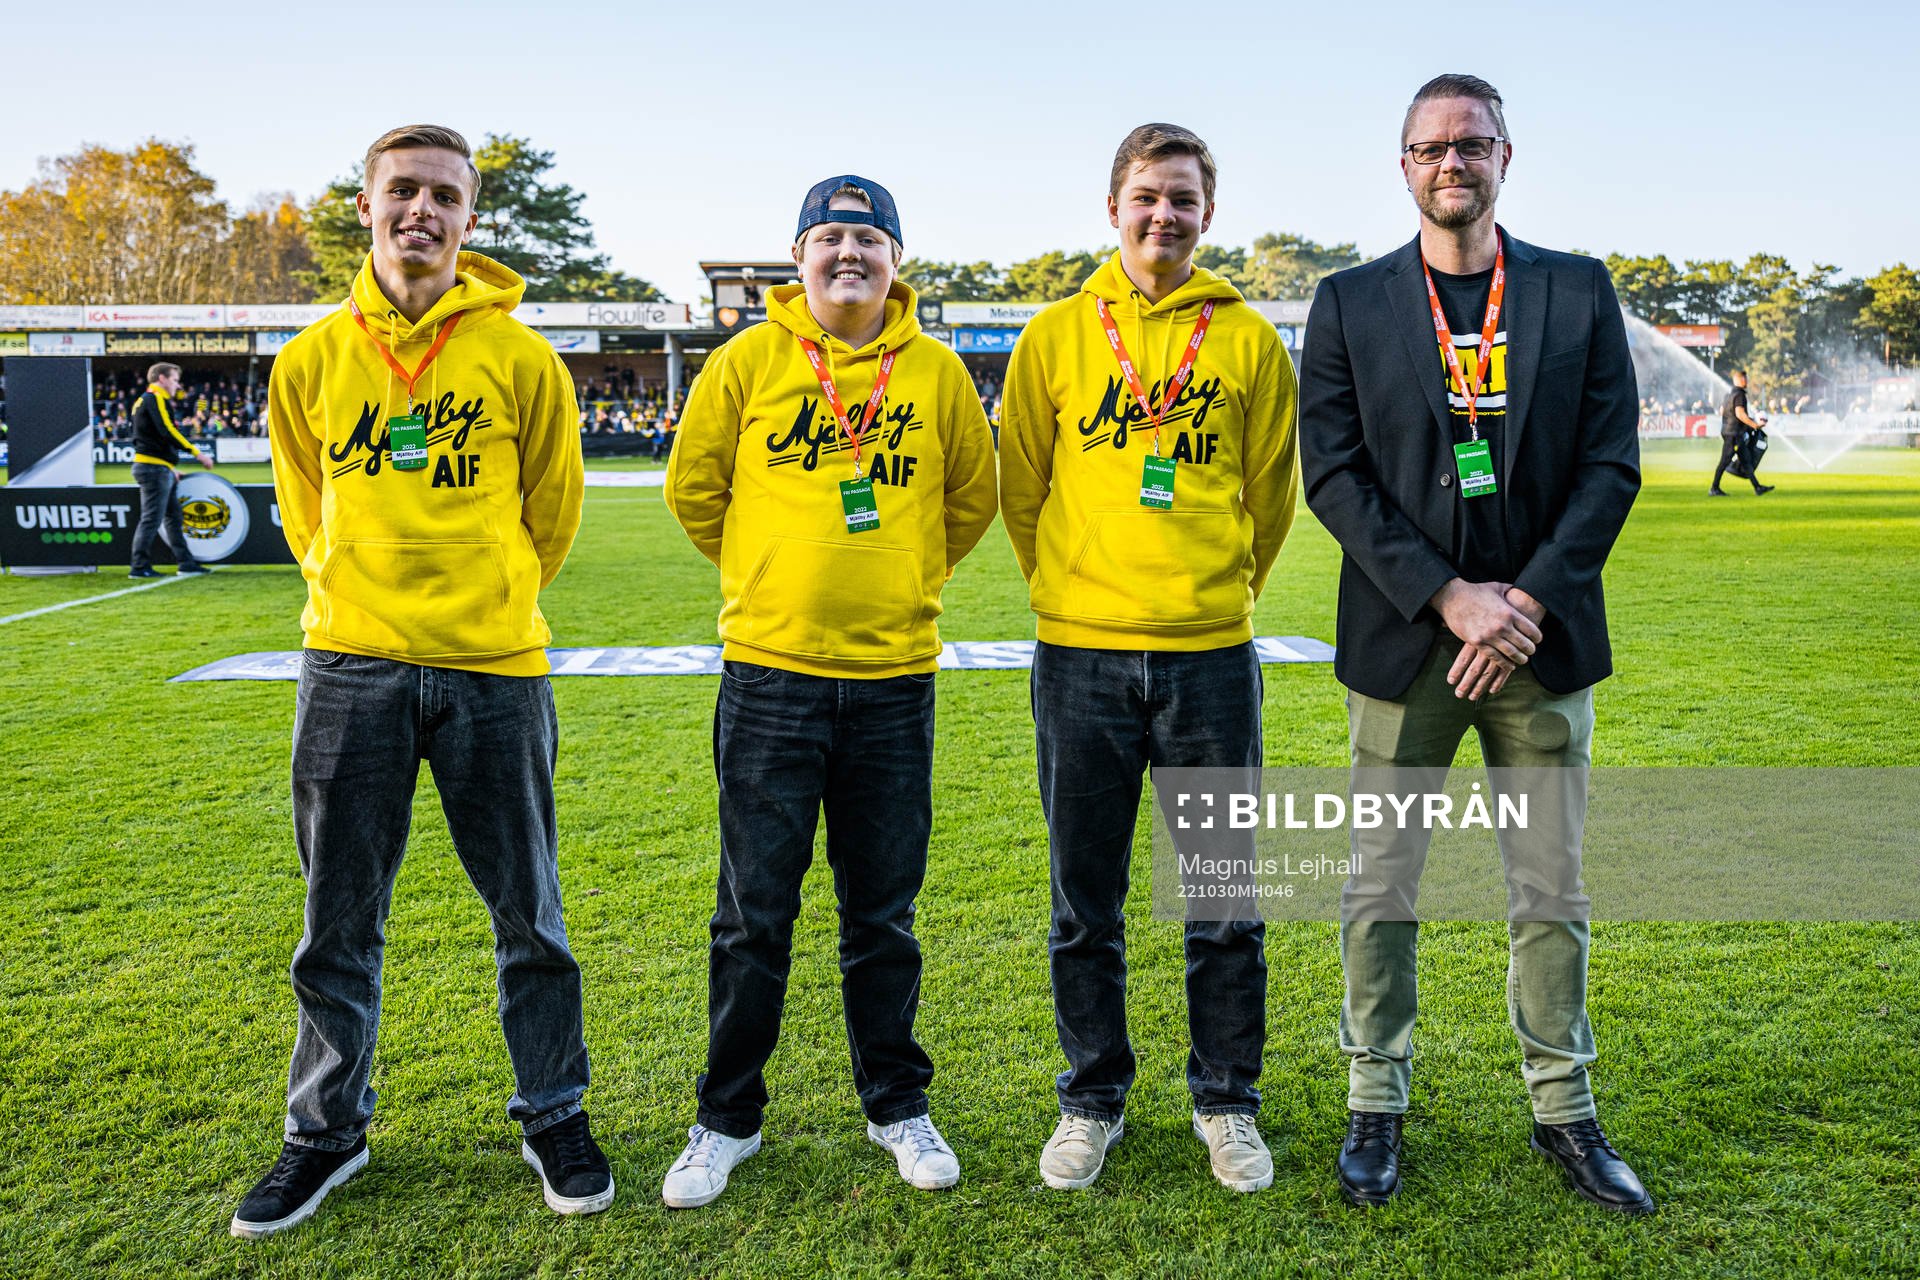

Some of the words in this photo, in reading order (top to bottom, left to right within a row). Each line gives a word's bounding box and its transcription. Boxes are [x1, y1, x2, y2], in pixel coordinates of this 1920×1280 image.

[88, 312, 108, 322] ICA
[588, 304, 666, 324] Flowlife
[106, 333, 160, 354] Sweden
[161, 334, 194, 354] Rock
[196, 333, 249, 354] Festival
[108, 442, 136, 462] ho
[1171, 432, 1219, 464] AIF
[432, 454, 480, 488] AIF
[869, 452, 918, 488] AIF
[16, 504, 130, 529] UNIBET
